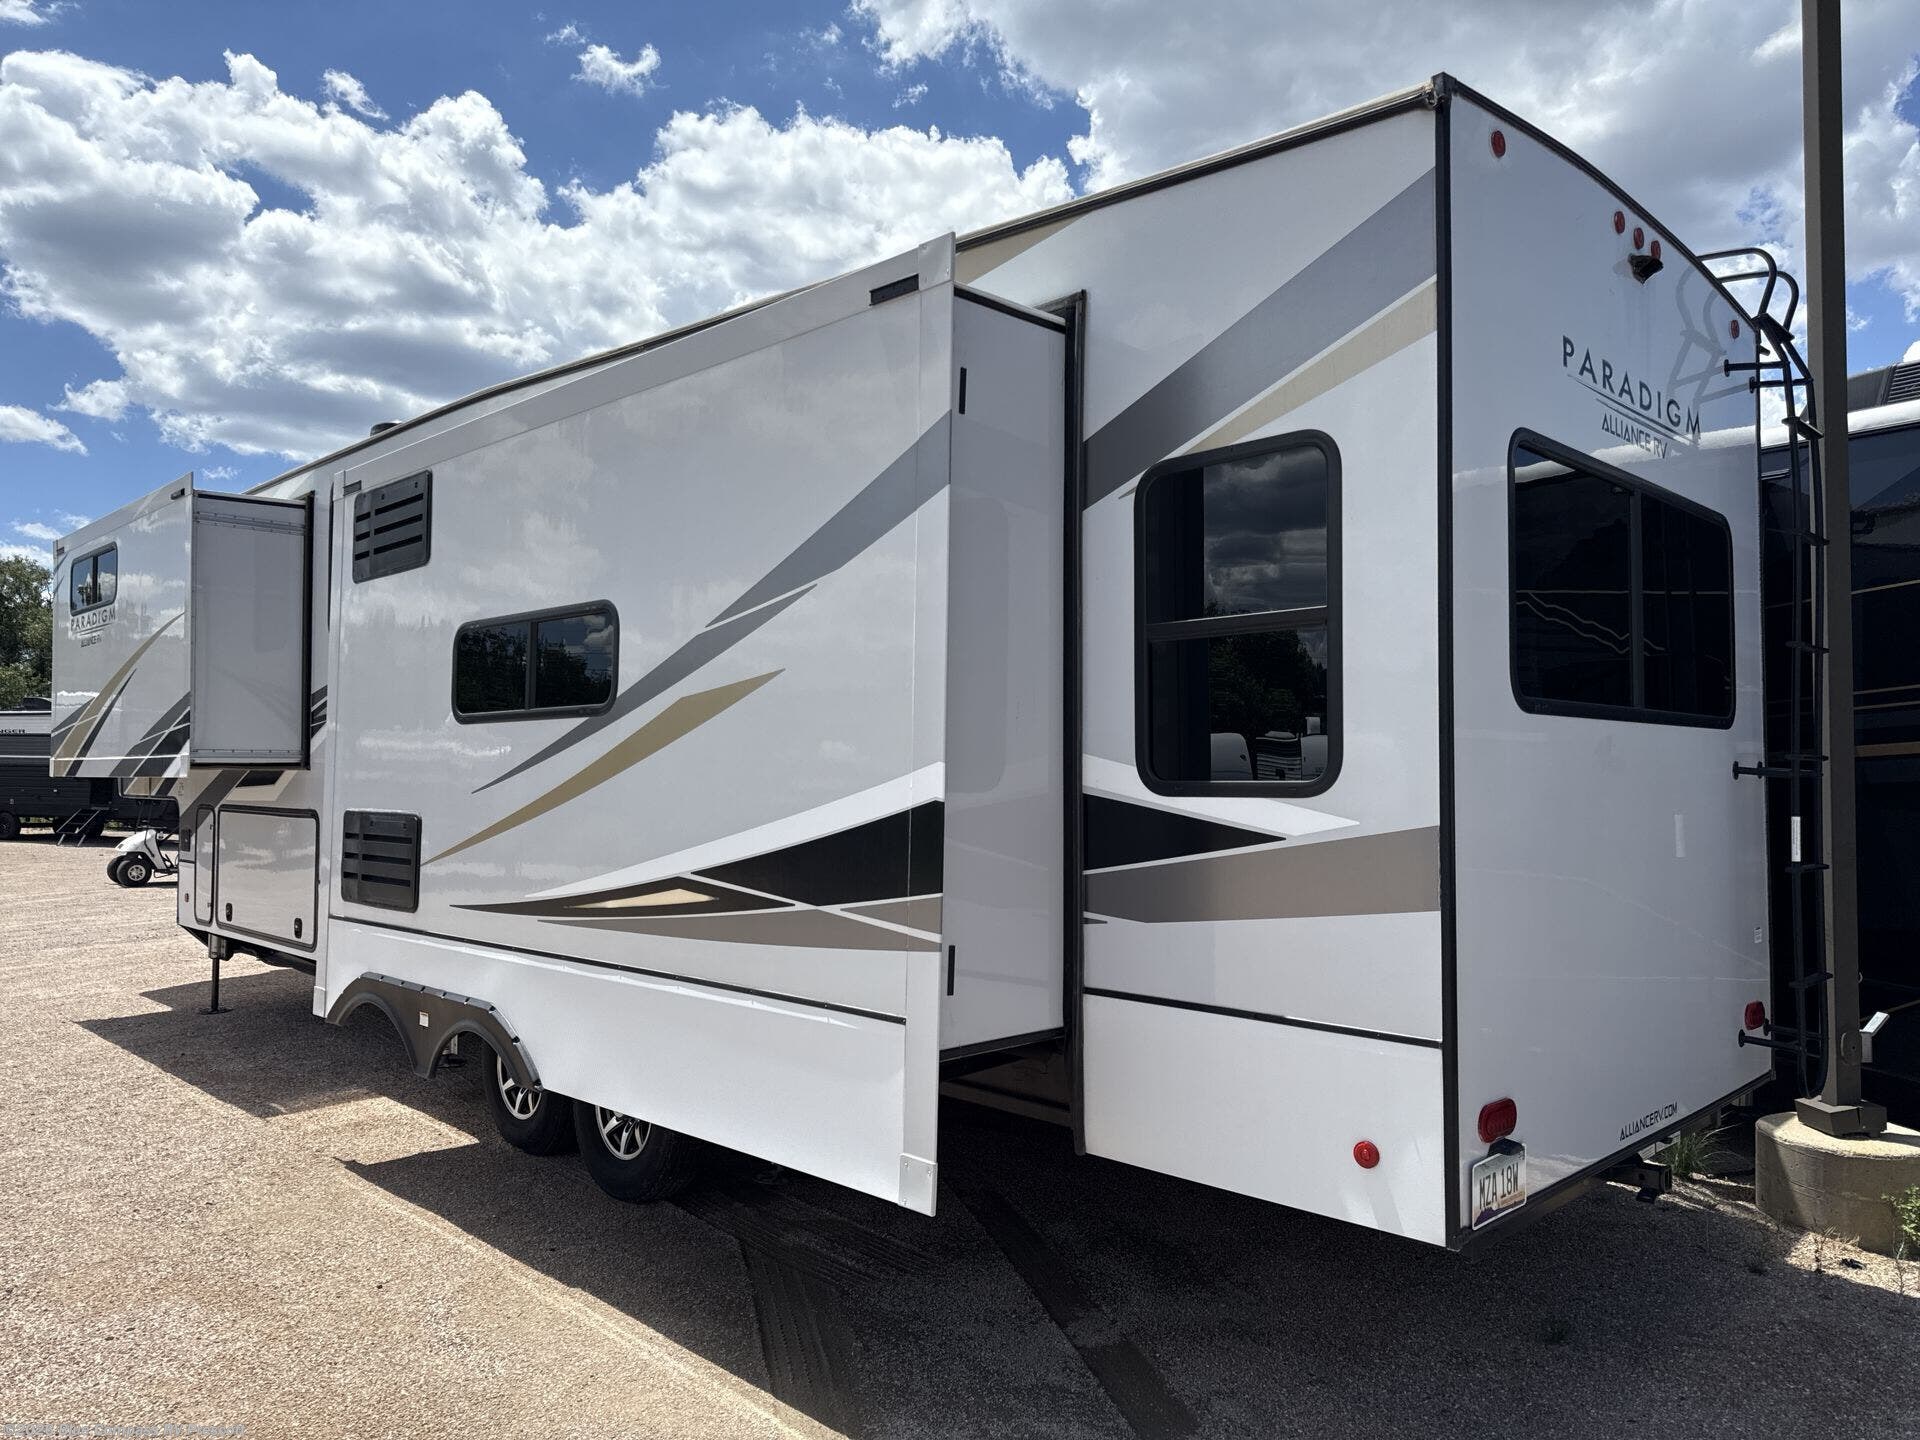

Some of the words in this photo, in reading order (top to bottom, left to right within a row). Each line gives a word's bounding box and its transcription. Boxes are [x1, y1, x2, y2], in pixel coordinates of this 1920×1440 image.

[1562, 334, 1702, 441] PARADIGM
[1601, 412, 1651, 452] ALLIANCE
[1653, 436, 1668, 459] RV
[71, 607, 116, 632] PARADIGM
[1619, 1101, 1678, 1141] ALLIANCERV.COM
